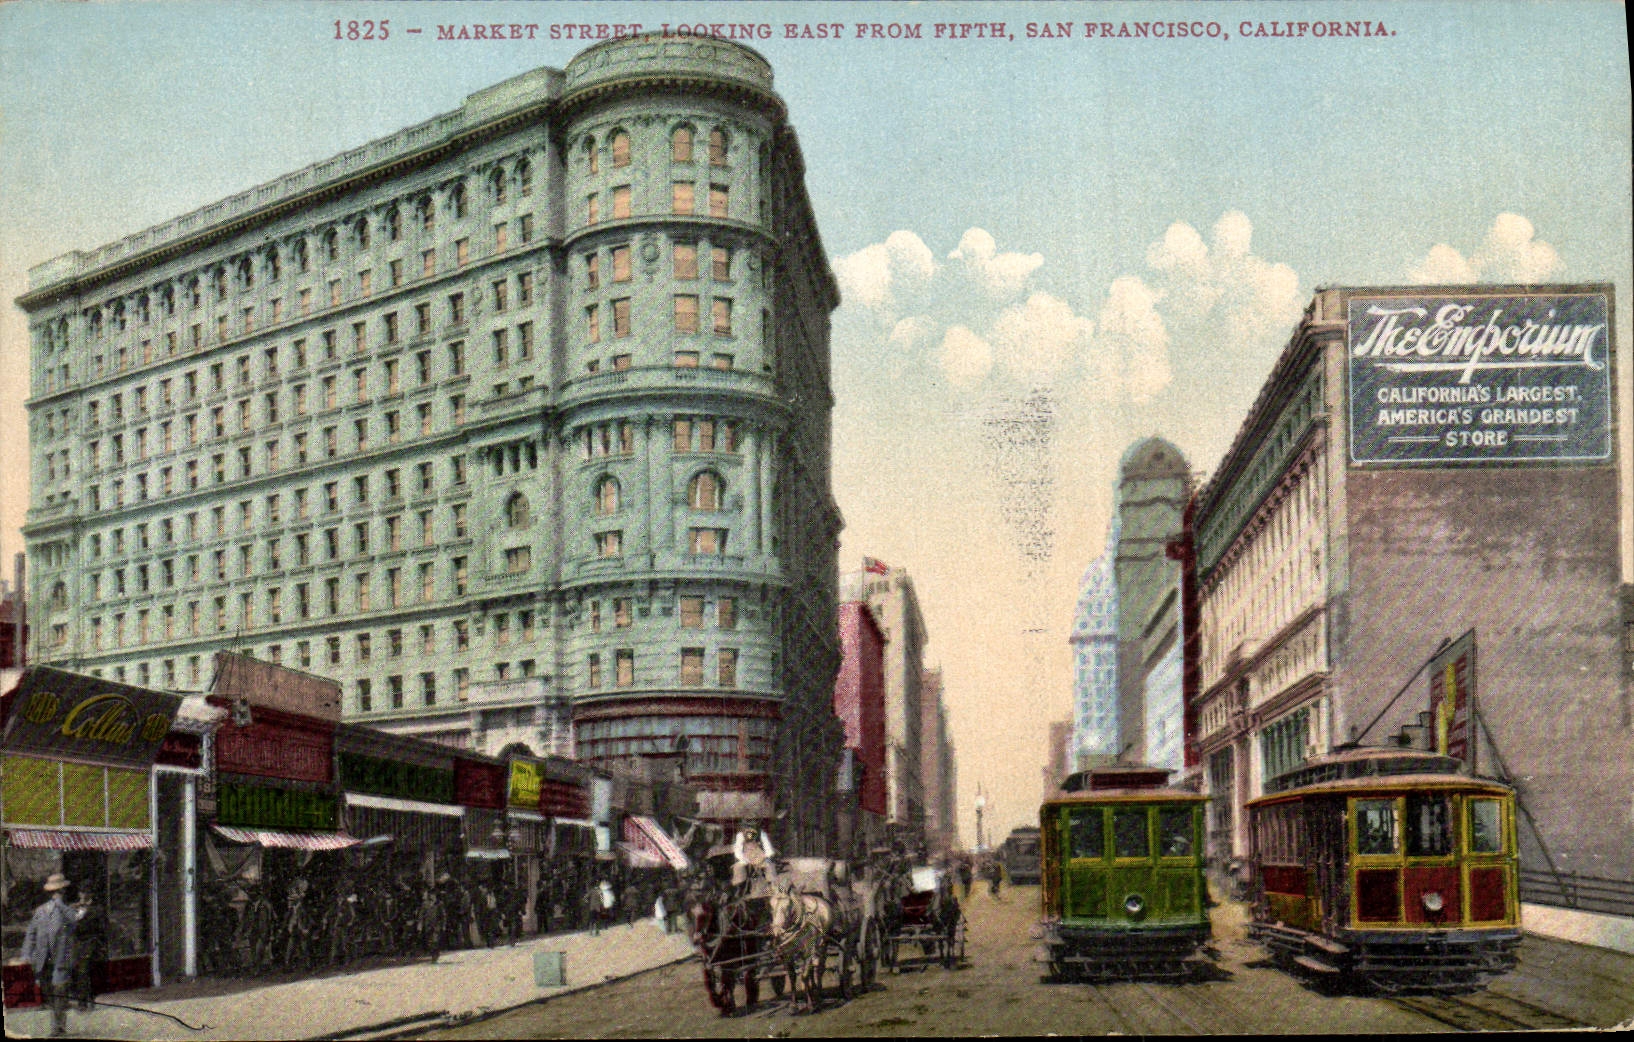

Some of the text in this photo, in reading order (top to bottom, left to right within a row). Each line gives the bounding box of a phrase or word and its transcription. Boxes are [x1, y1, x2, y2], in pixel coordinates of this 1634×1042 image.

[1352, 303, 1606, 384] The Emporium
[1377, 384, 1491, 404] CALIFORNIA'S
[1377, 407, 1580, 426] AMERICA'S GRANDEST
[1445, 430, 1509, 447] STORE
